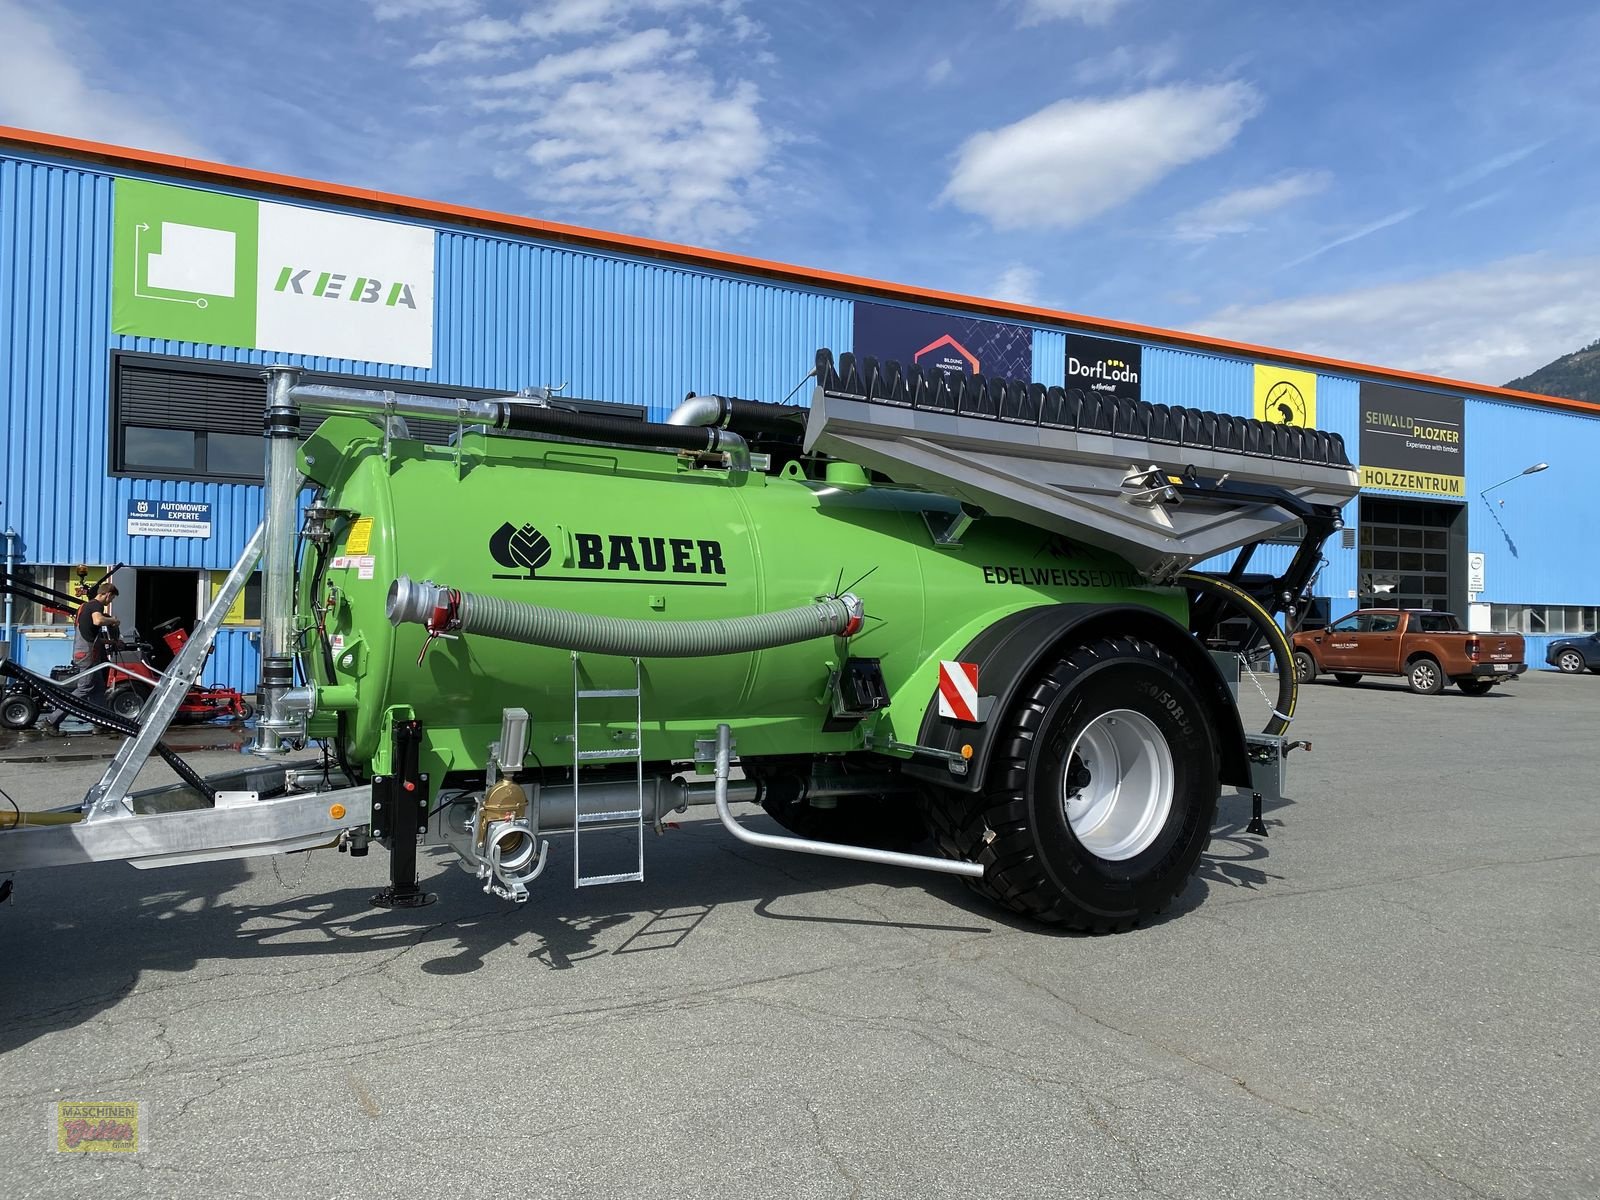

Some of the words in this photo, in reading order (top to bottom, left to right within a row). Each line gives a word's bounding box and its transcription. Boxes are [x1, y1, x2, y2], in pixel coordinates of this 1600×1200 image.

[274, 267, 417, 309] KEBA
[936, 363, 963, 371] INNOVATION
[943, 357, 963, 365] BILDUNG
[1365, 411, 1414, 429] SEIWALD
[1406, 441, 1431, 450] Experience
[1365, 470, 1459, 493] HOLZZENTRUM
[168, 511, 200, 520] EXPERTE
[574, 533, 727, 574] BAUER
